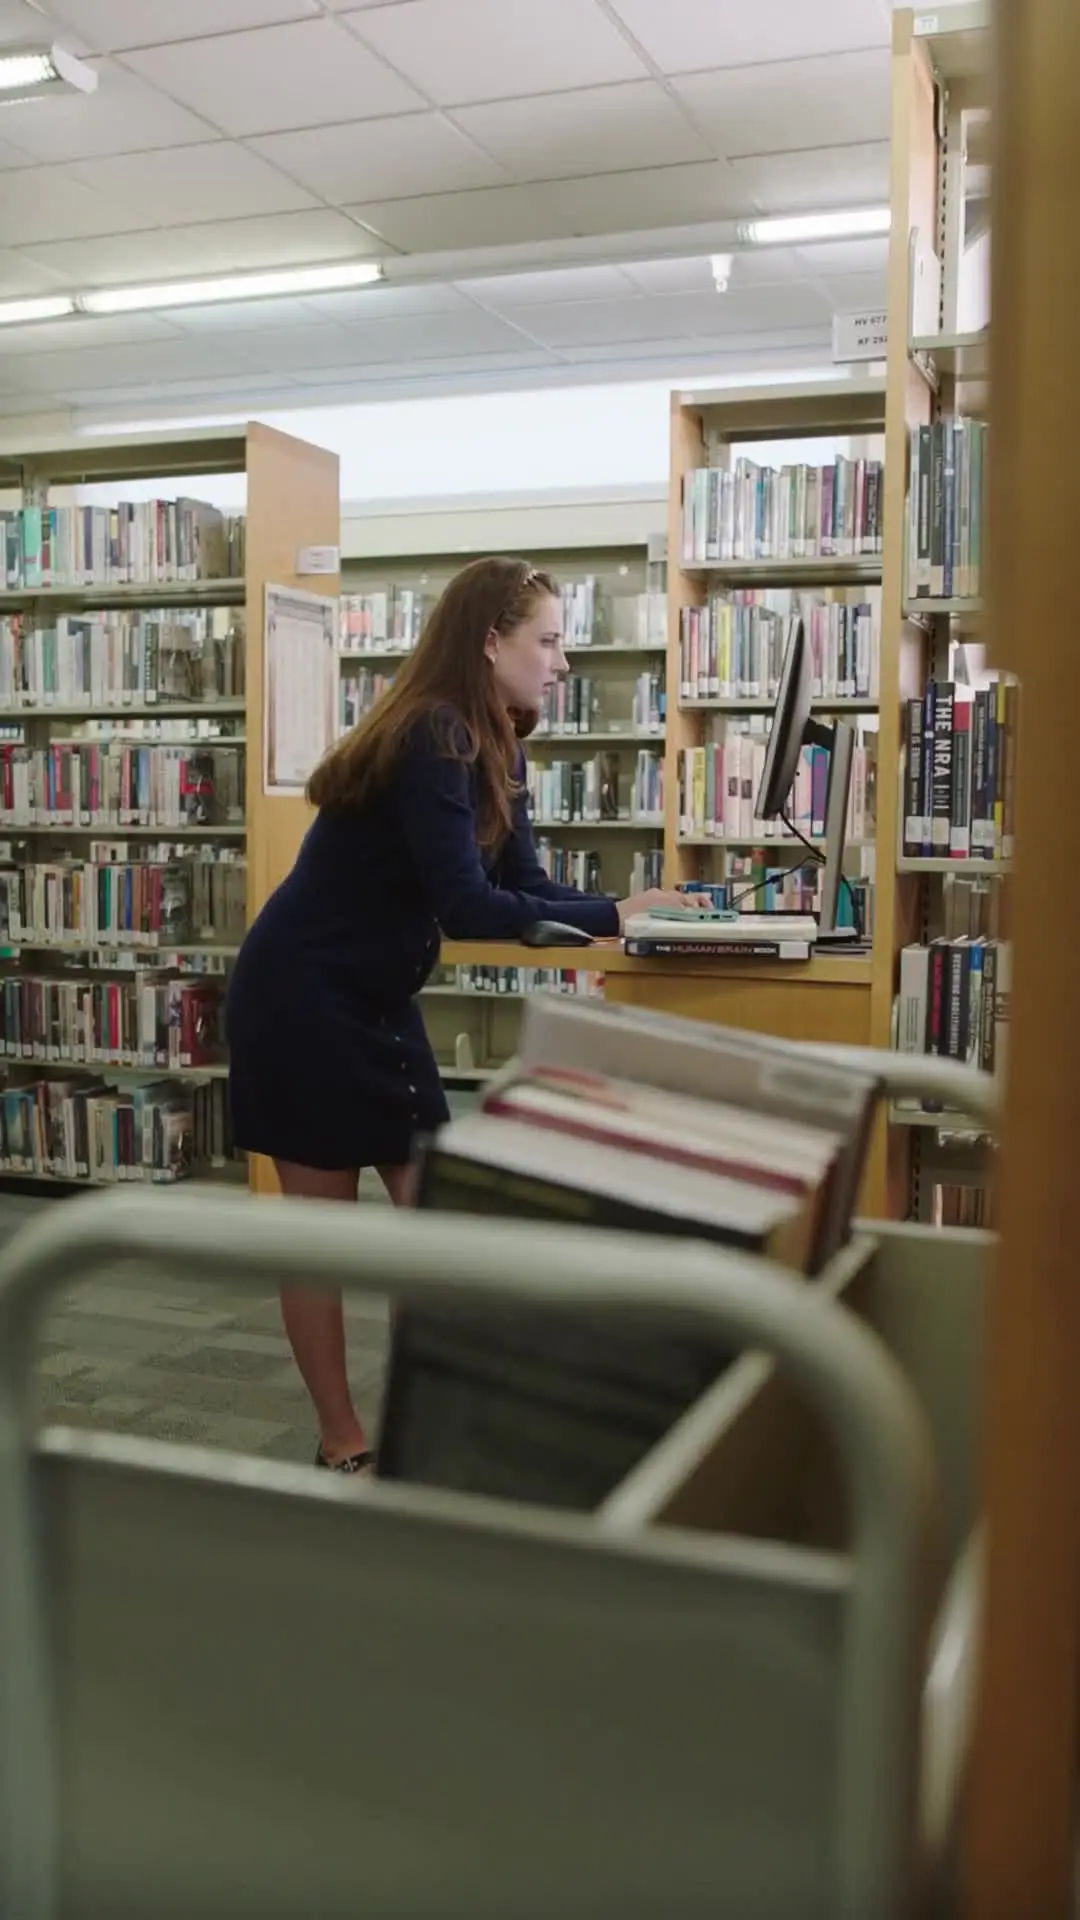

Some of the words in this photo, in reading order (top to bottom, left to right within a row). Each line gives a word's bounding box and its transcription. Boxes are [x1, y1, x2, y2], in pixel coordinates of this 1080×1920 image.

[934, 695, 952, 732] THE
[933, 739, 951, 777] NRA
[672, 944, 714, 953] HUMAN
[716, 944, 752, 954] BRAIN
